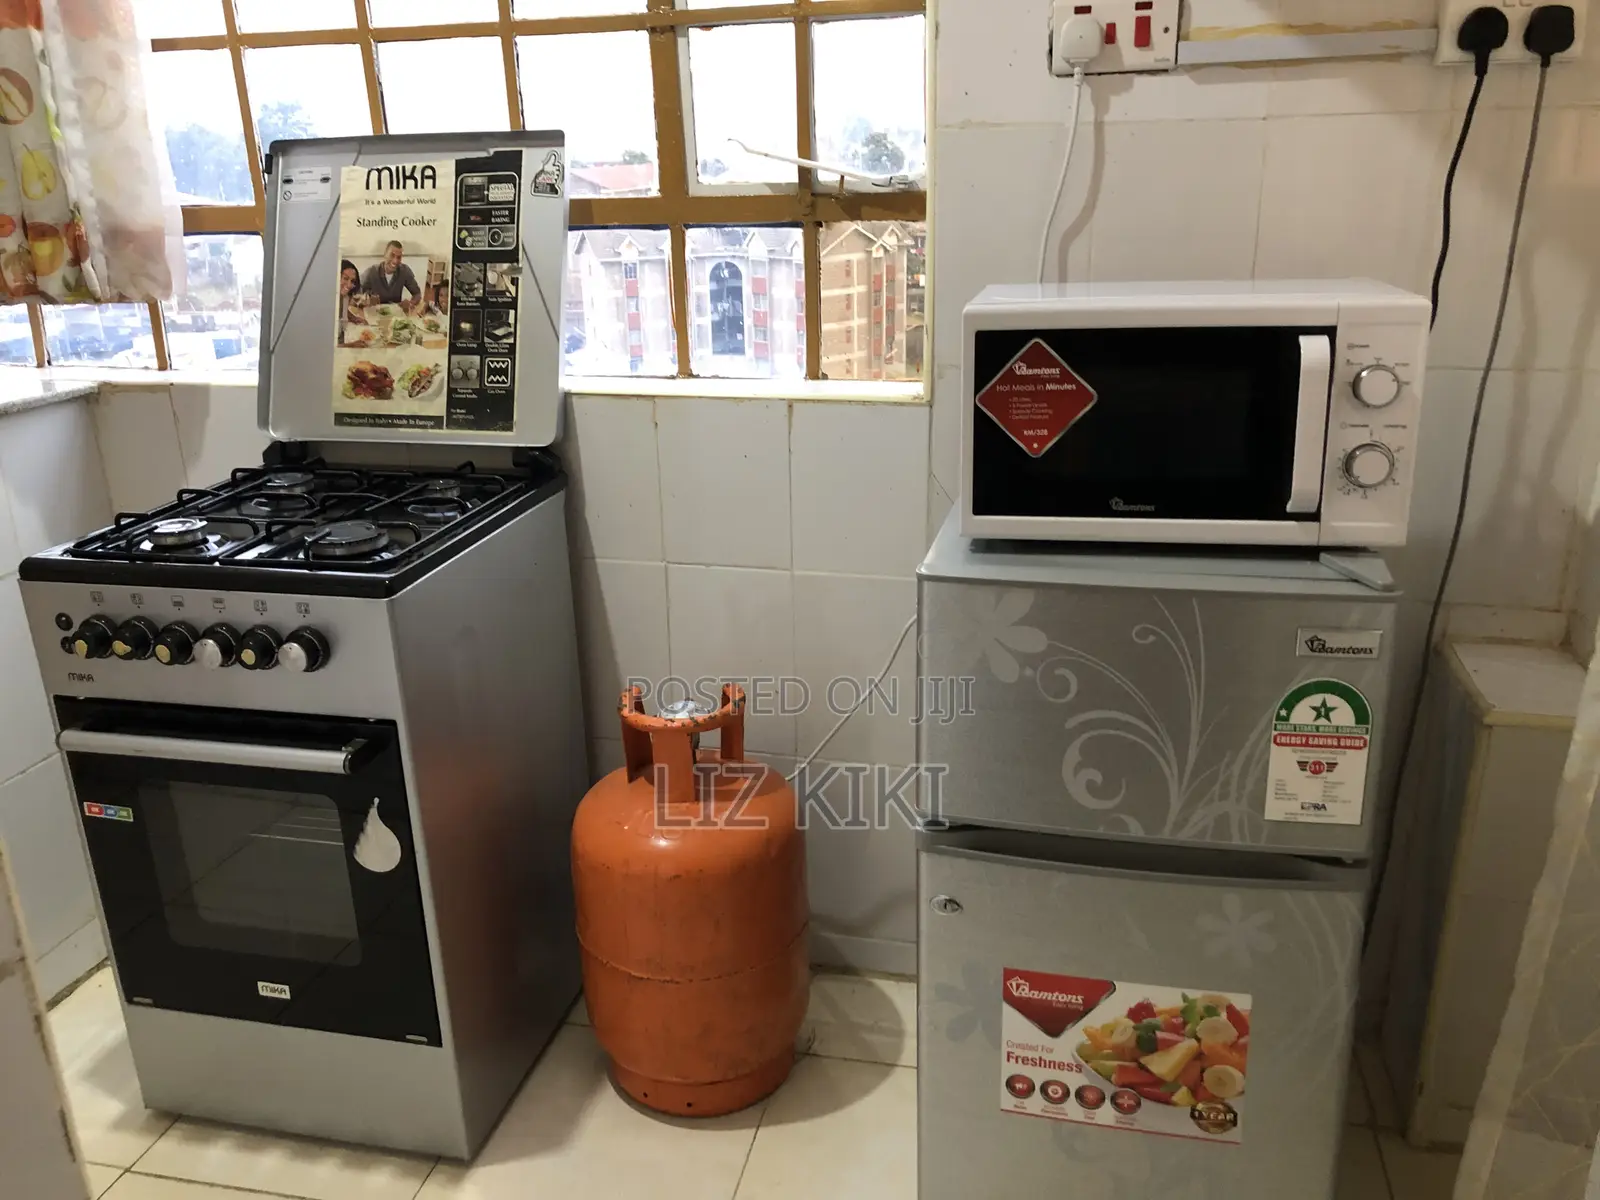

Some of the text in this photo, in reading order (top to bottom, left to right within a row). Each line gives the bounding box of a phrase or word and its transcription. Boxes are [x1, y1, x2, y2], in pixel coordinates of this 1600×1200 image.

[366, 165, 436, 190] MIKA
[417, 197, 436, 205] World
[356, 216, 437, 230] Standing Cooker
[997, 384, 1010, 392] Hot
[1012, 383, 1035, 391] Meals
[1045, 382, 1076, 391] Minutes
[68, 672, 94, 682] MIKA
[1276, 735, 1364, 747] ENERGY SAVING GUIDE
[1007, 976, 1084, 1004] Ramtons
[1006, 1040, 1054, 1054] Created For
[1006, 1051, 1083, 1074] Freshness
